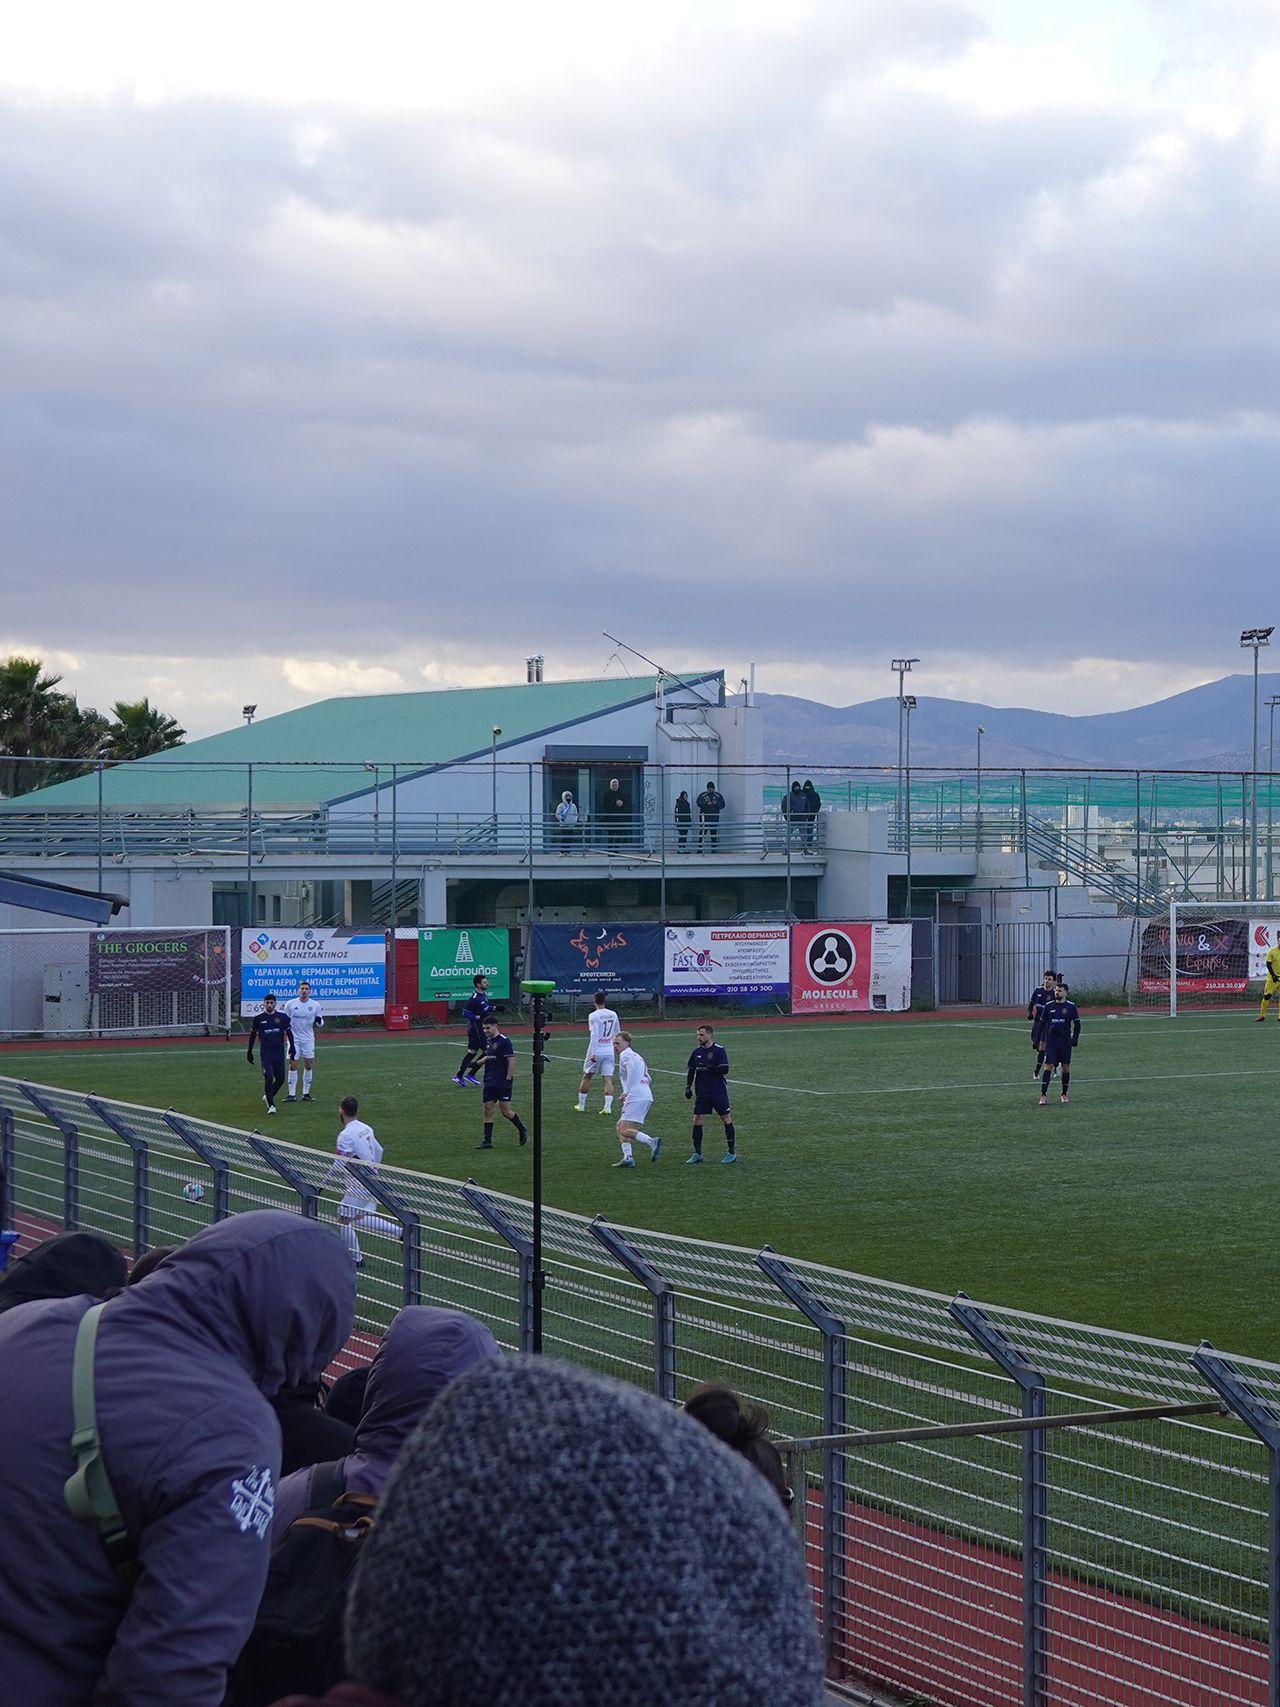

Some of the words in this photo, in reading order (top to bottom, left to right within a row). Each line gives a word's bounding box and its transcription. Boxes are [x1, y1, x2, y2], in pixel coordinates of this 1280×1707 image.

[712, 932, 747, 940] ΠΕΤΡΕΛΑΙΟ
[96, 943, 122, 954] THE
[125, 942, 188, 954] GROCERS
[269, 940, 325, 951] ΚΑΠΠΟΣ
[1197, 934, 1211, 951] &
[283, 951, 349, 959] ΚΩΝΣΤΑΝΤΙΝΟΣ
[673, 953, 693, 967] FAST
[253, 968, 293, 976] ΥΔΡΑΥΛΙΚΑ
[301, 968, 339, 976] ΘΕΡΜΑΝΣΗ
[348, 967, 375, 975] ΗΛΙΑΚΑ
[248, 979, 273, 987] ΦΥΣΙΚΟ
[276, 978, 297, 987] ΑΕΡΙΟ
[335, 977, 380, 986] ΘΕΡΜΟΤΗΤΑΣ
[320, 987, 358, 996] ΘΕΡΜΑΝΣΗ
[801, 989, 859, 1000] MOLECULE
[603, 1020, 614, 1037] 17
